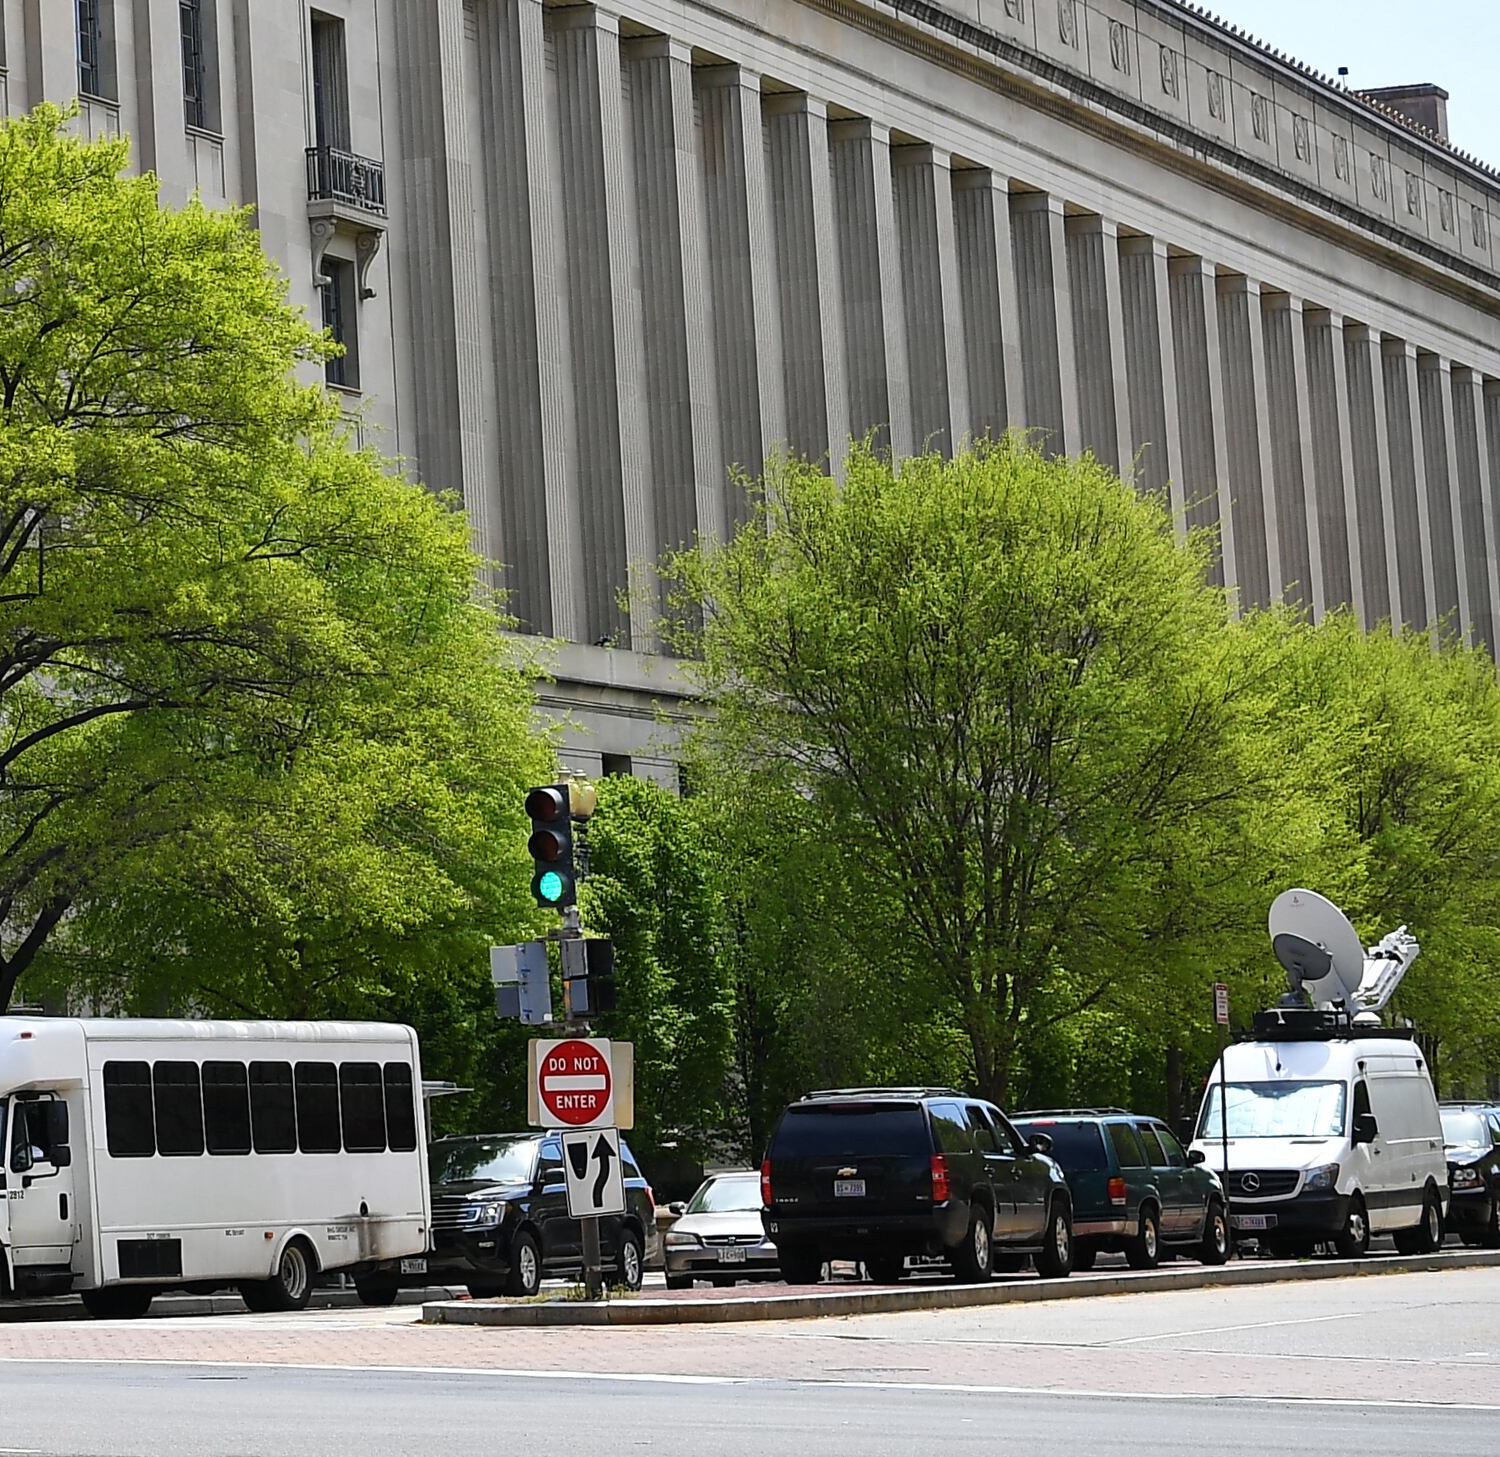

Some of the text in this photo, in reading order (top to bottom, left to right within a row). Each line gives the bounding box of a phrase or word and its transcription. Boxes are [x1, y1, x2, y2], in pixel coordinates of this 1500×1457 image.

[549, 1057, 599, 1071] DO NOT
[556, 1095, 596, 1109] ENTER
